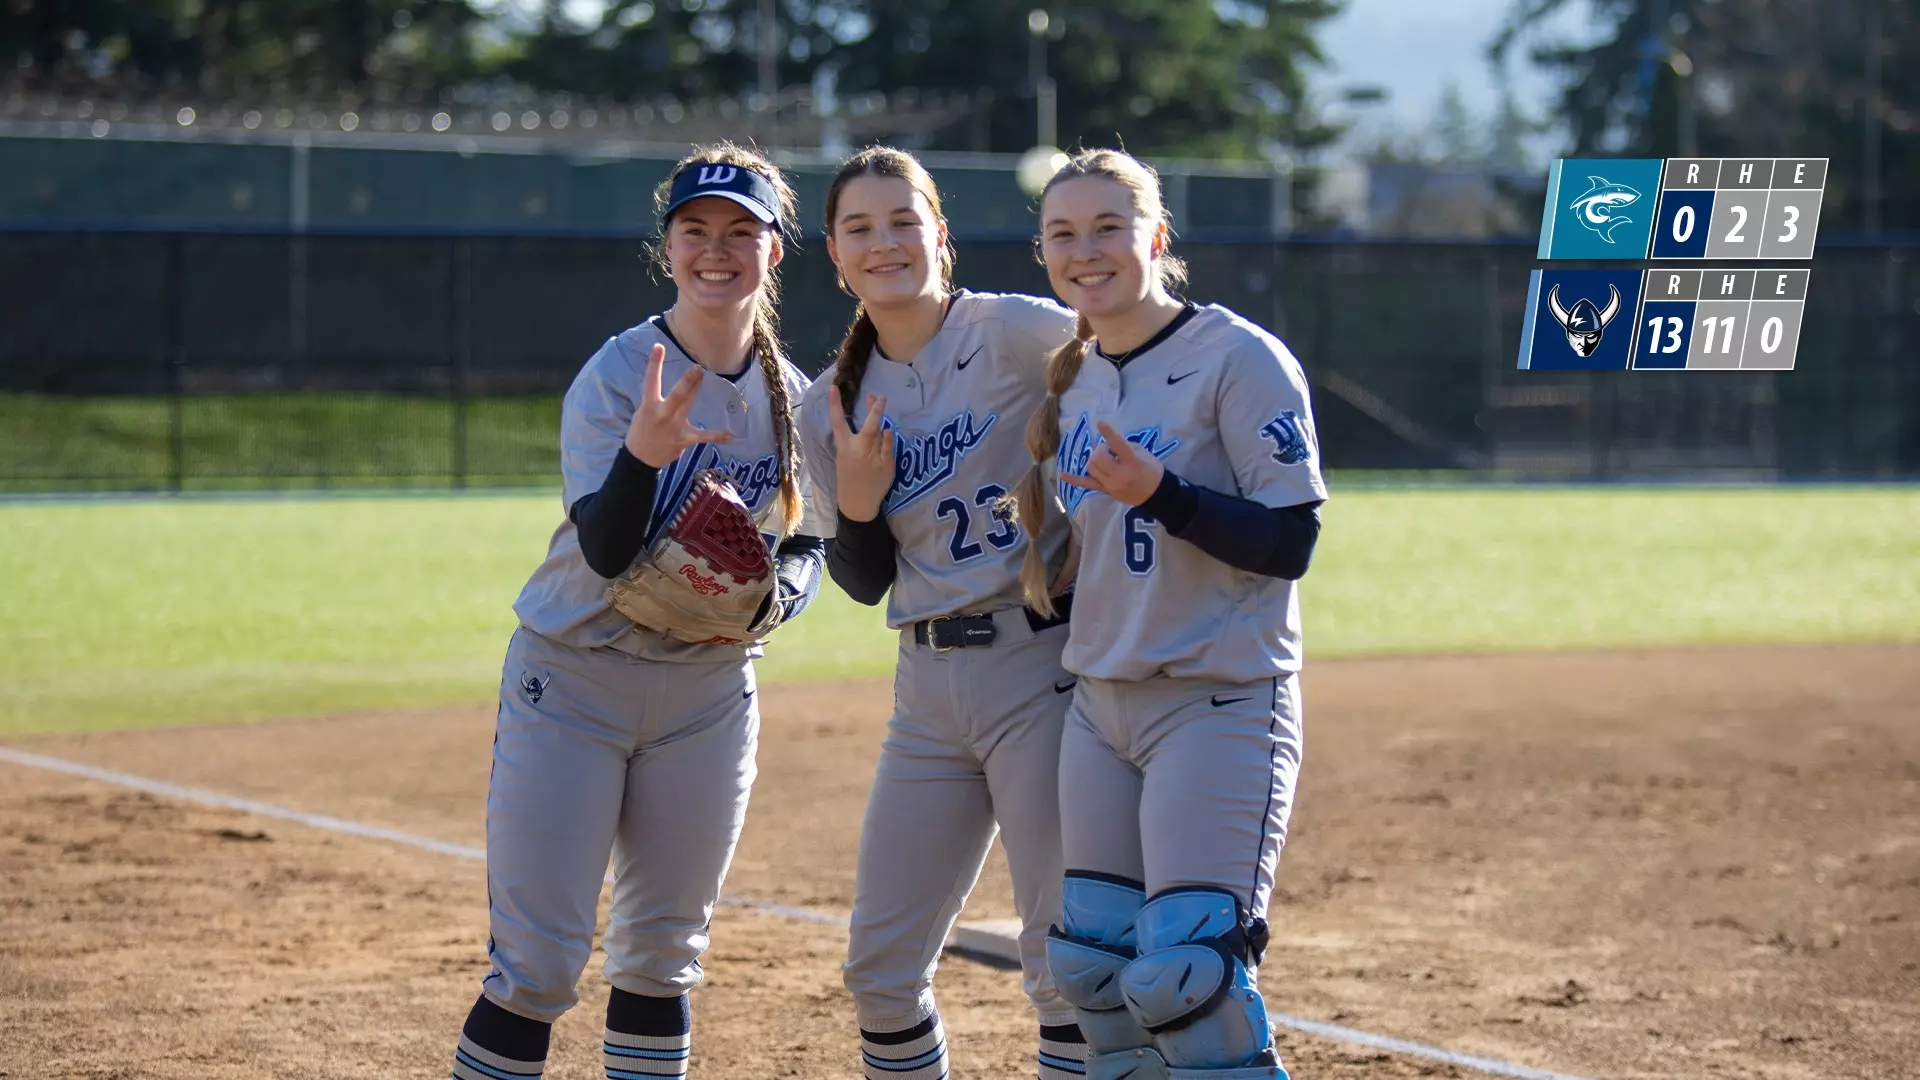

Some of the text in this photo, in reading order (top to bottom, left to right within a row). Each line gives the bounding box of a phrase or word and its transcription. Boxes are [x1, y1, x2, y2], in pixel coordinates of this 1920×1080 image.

[935, 483, 1021, 564] 23
[1123, 507, 1158, 576] 6
[679, 564, 729, 596] Rawlings
